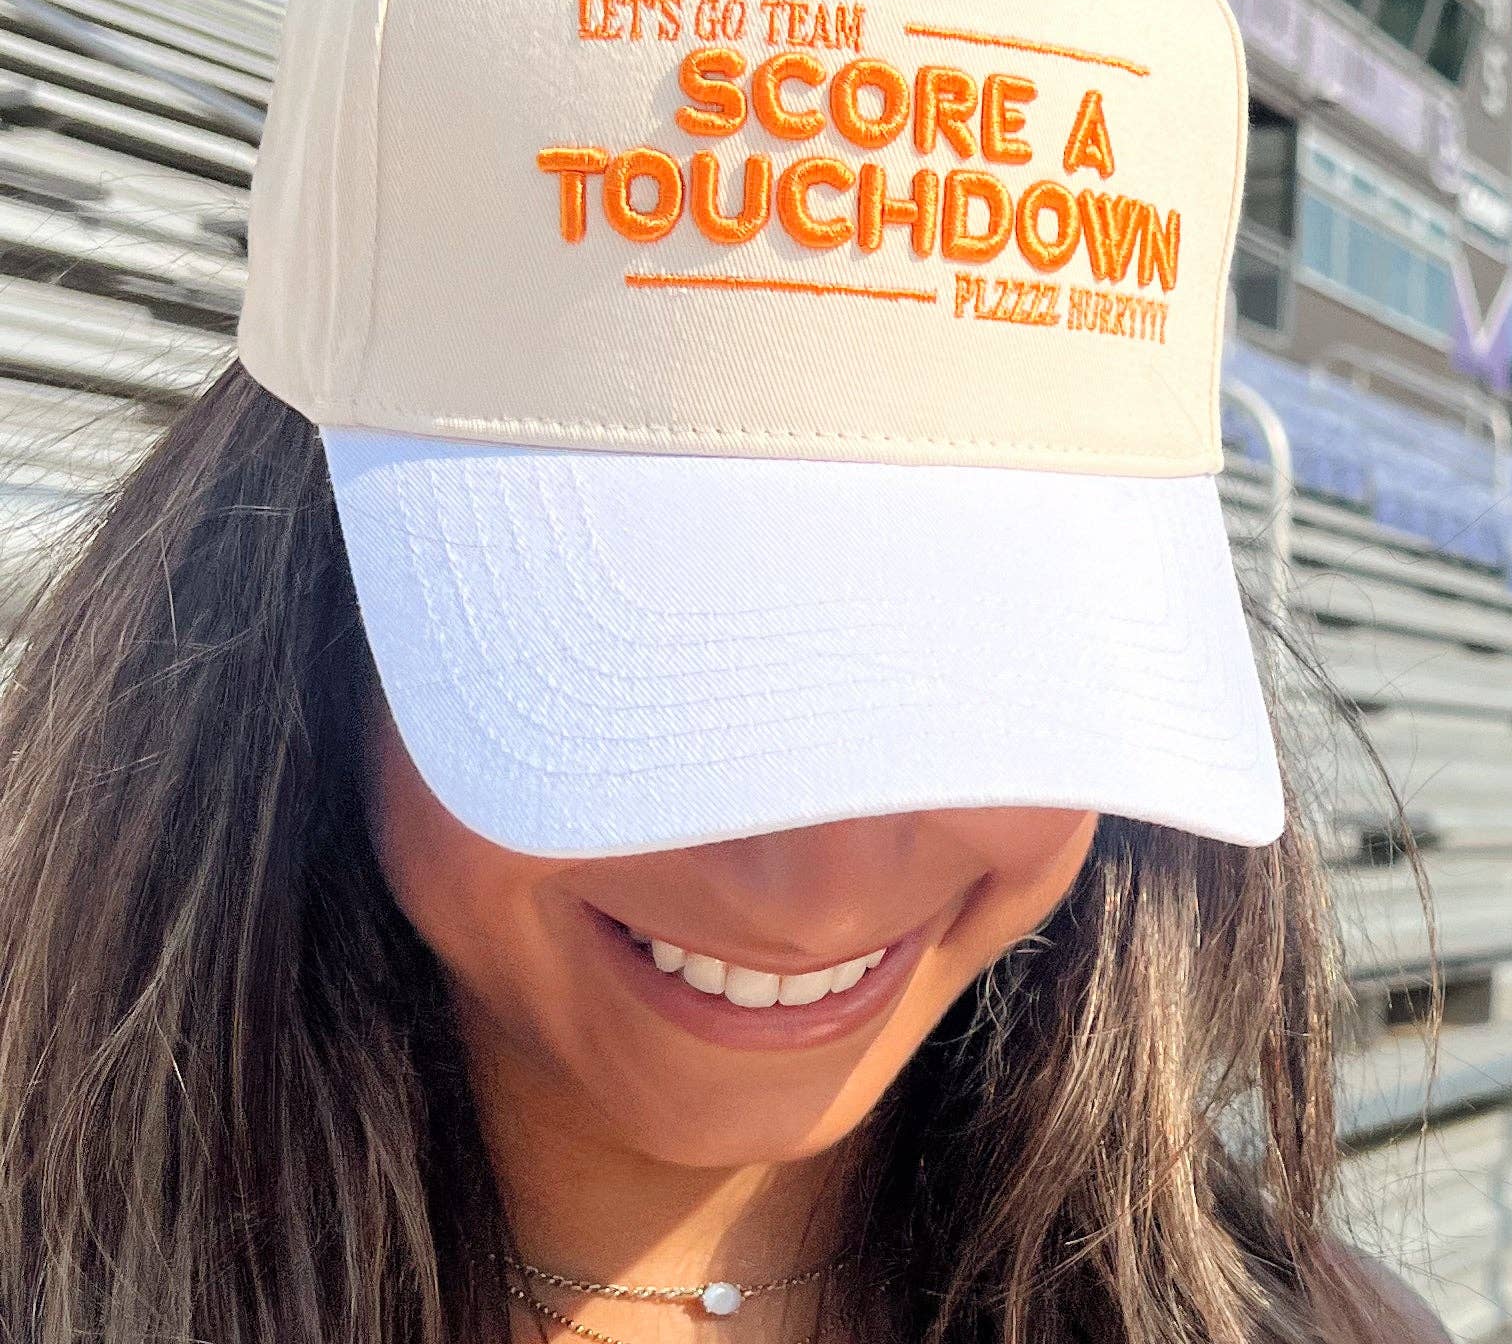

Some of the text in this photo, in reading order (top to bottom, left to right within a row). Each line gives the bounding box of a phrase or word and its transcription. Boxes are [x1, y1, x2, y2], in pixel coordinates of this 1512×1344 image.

[675, 46, 1116, 179] SCORE A
[536, 145, 1182, 292] TOUCHDOWN
